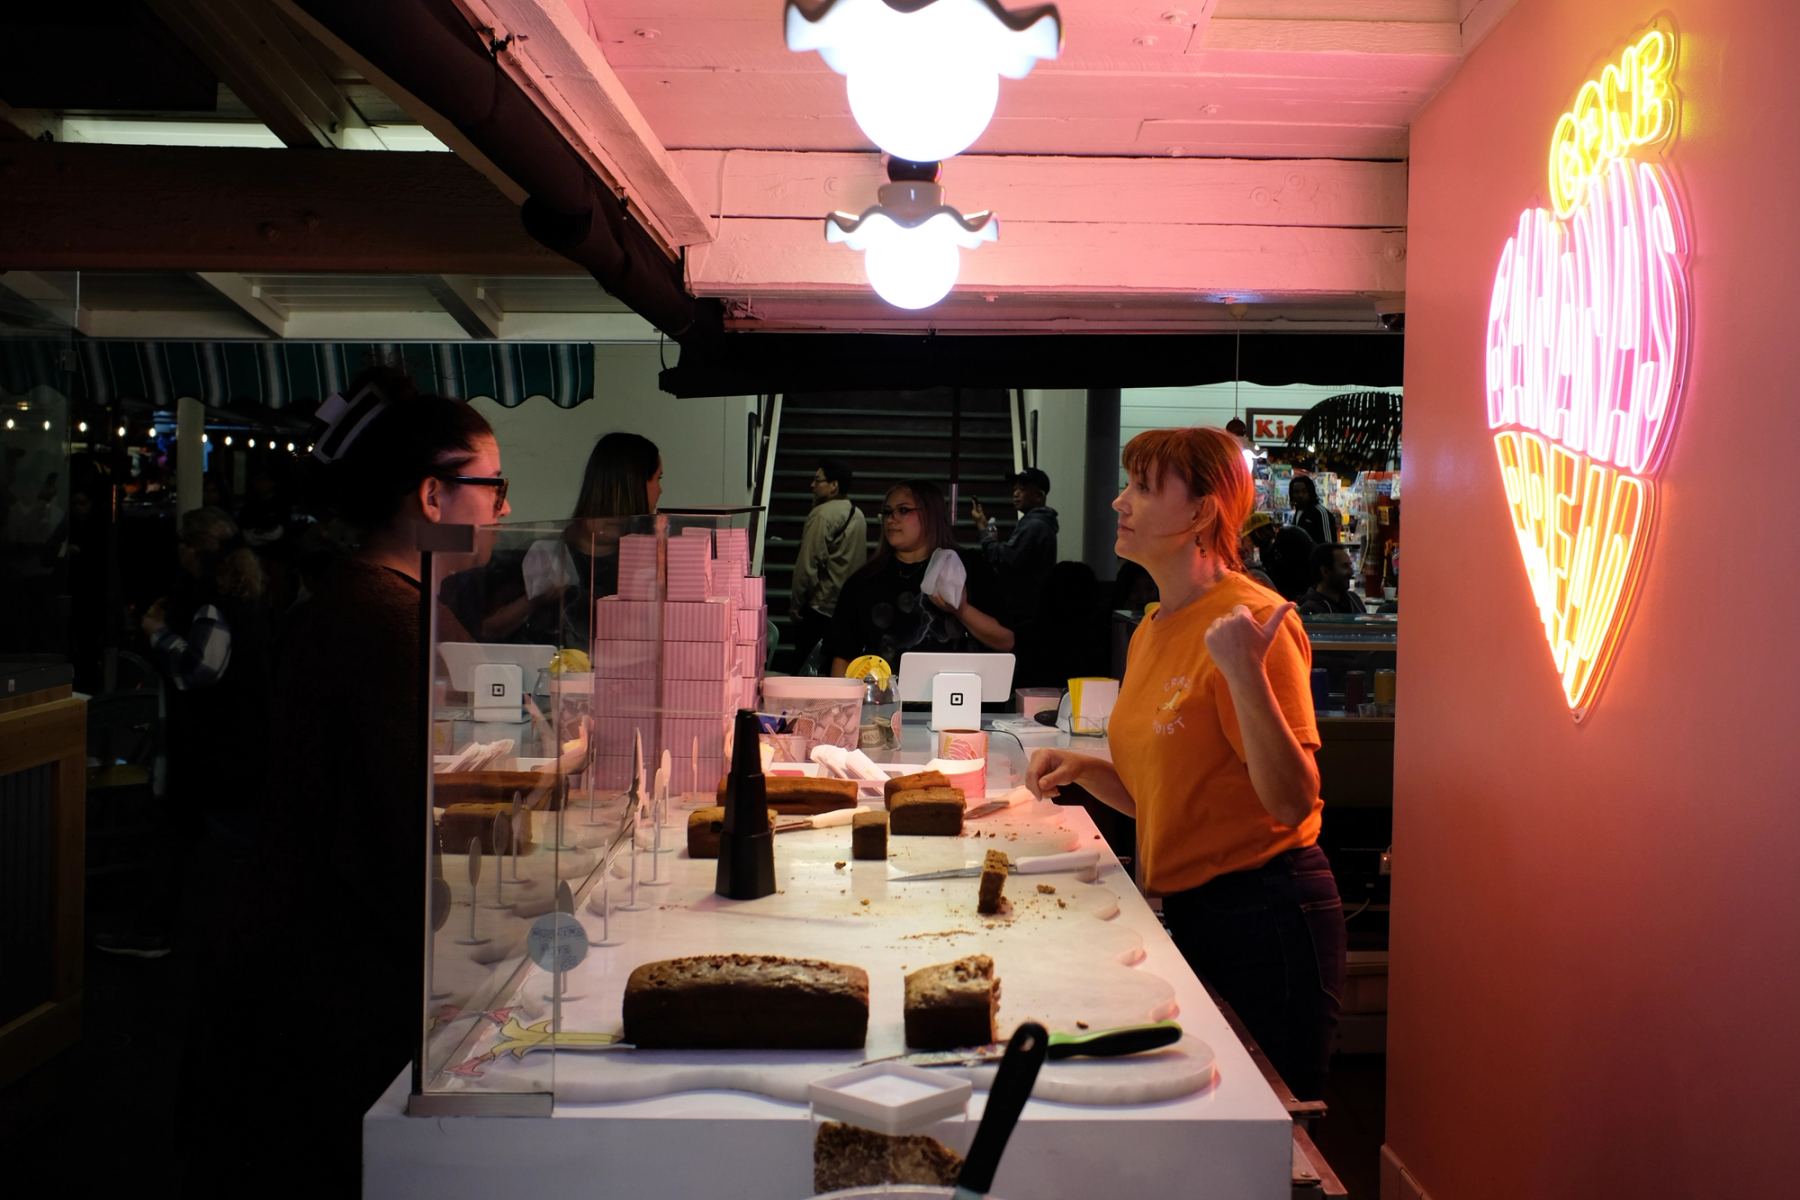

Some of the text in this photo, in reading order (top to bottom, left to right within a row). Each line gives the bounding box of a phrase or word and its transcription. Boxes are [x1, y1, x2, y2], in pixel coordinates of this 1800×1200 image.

[1549, 30, 1671, 220] GONE
[1486, 158, 1679, 474] BANANAS
[1494, 431, 1647, 709] BREAD
